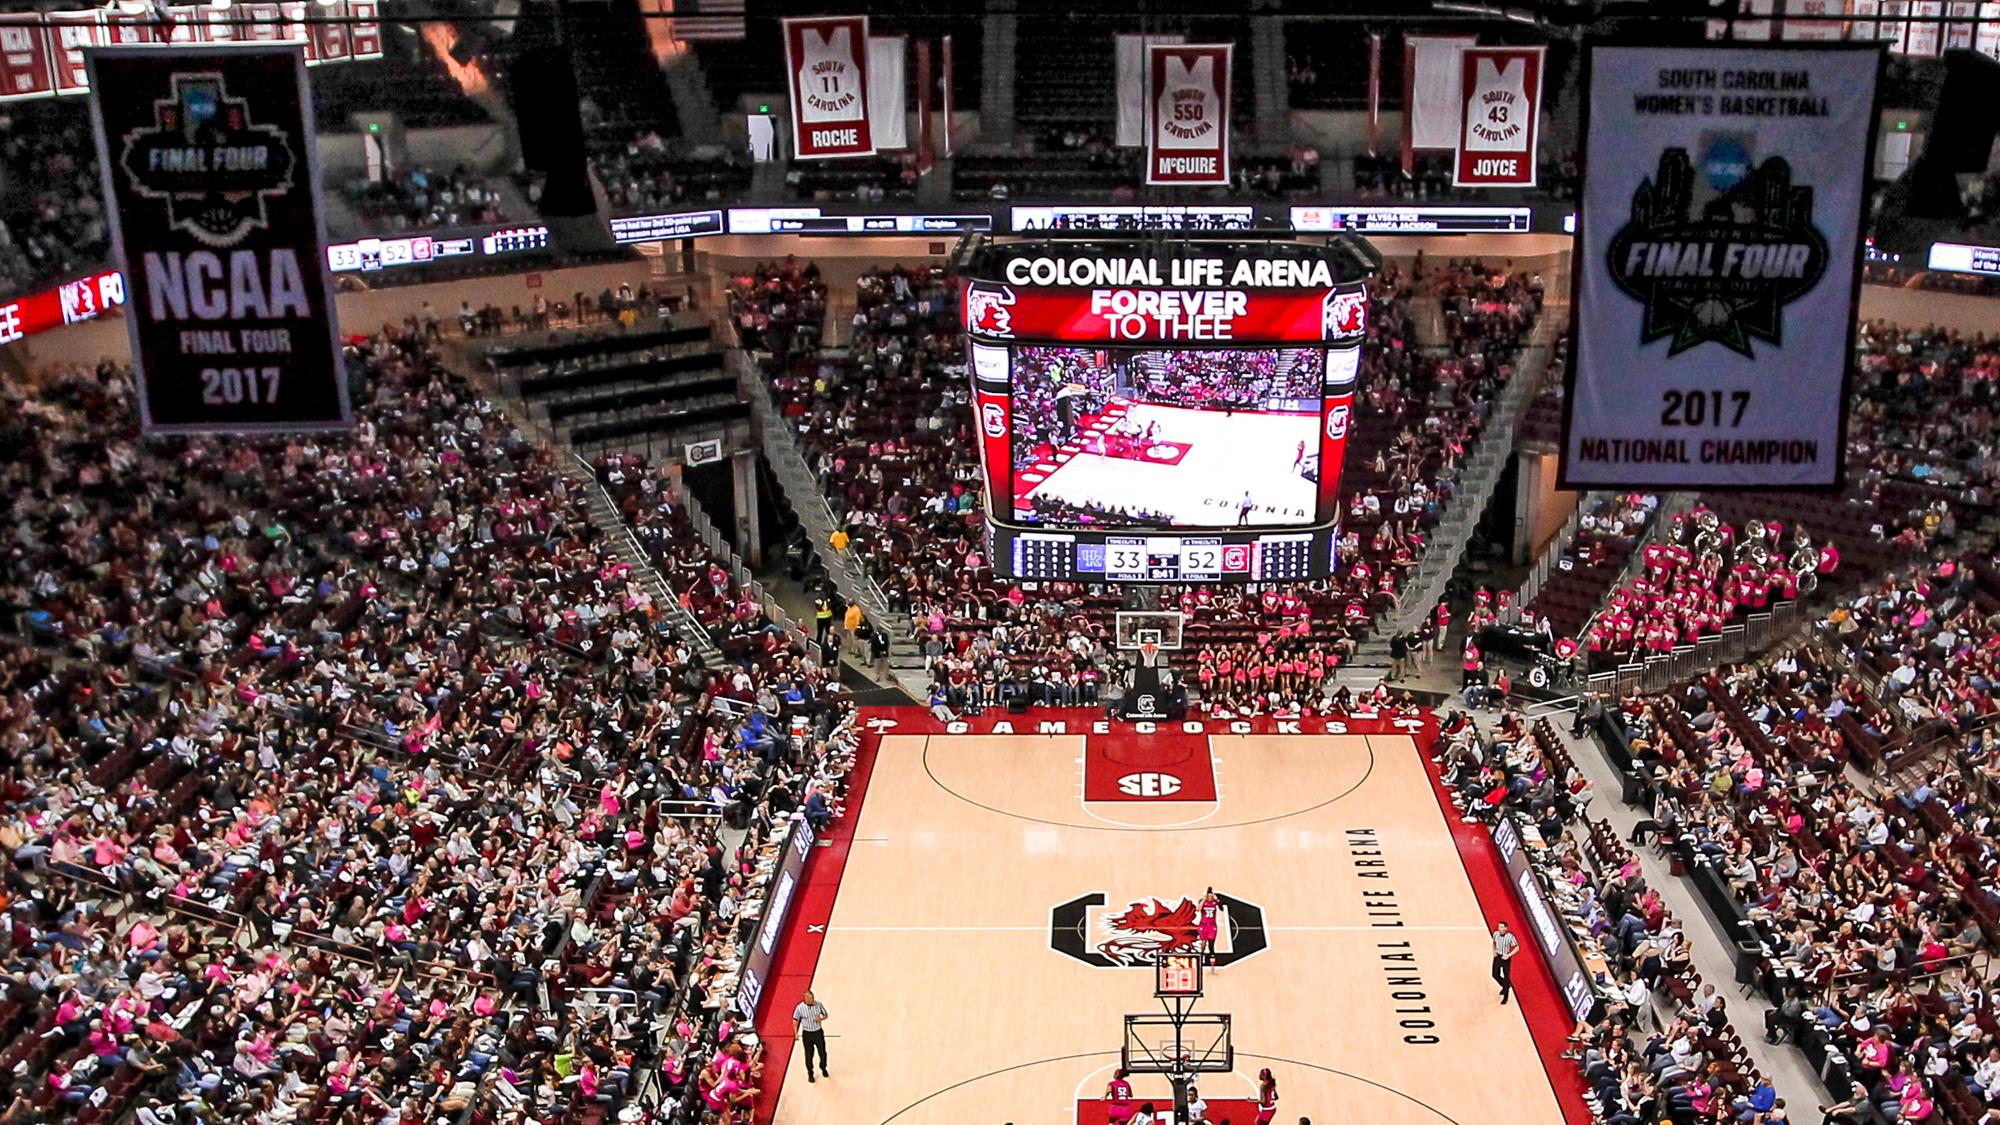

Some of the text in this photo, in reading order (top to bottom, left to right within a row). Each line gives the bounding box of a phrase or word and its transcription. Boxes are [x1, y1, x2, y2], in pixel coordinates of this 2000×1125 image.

[812, 61, 845, 74] SOUTH
[822, 76, 838, 93] 11
[1658, 69, 1809, 90] SOUTH CAROLINA
[808, 92, 855, 111] CAROLINA
[1482, 90, 1516, 104] SOUTH
[1634, 94, 1830, 116] WOMEN'S BASKETBALL
[1174, 104, 1204, 121] 550
[1488, 106, 1508, 123] 43
[812, 129, 858, 148] ROCHE
[1164, 121, 1213, 139] CAROLINA
[1473, 123, 1521, 142] CAROLINA
[149, 146, 268, 171] FINAL FOUR
[1472, 159, 1517, 176] JOYCE
[335, 251, 356, 266] 33
[386, 245, 407, 260] 52
[1625, 241, 1811, 279] FINAL FOUR
[1006, 257, 1333, 288] COLONIAL LIFE ARENA
[144, 248, 311, 320] NCAA
[1091, 290, 1248, 316] FOREVER
[1103, 315, 1233, 341] TO THEE
[180, 328, 292, 354] FINAL FOUR
[201, 366, 281, 405] 2017
[1661, 390, 1750, 427] 2017
[1580, 438, 1818, 465] NATIONAL CHAMPION
[1113, 551, 1140, 568] 33
[1188, 551, 1215, 569] 52
[946, 721, 1347, 735] GAMECOCKS
[1118, 772, 1182, 798] SEC
[1345, 828, 1440, 1044] COLONIAL LIFE ARENA
